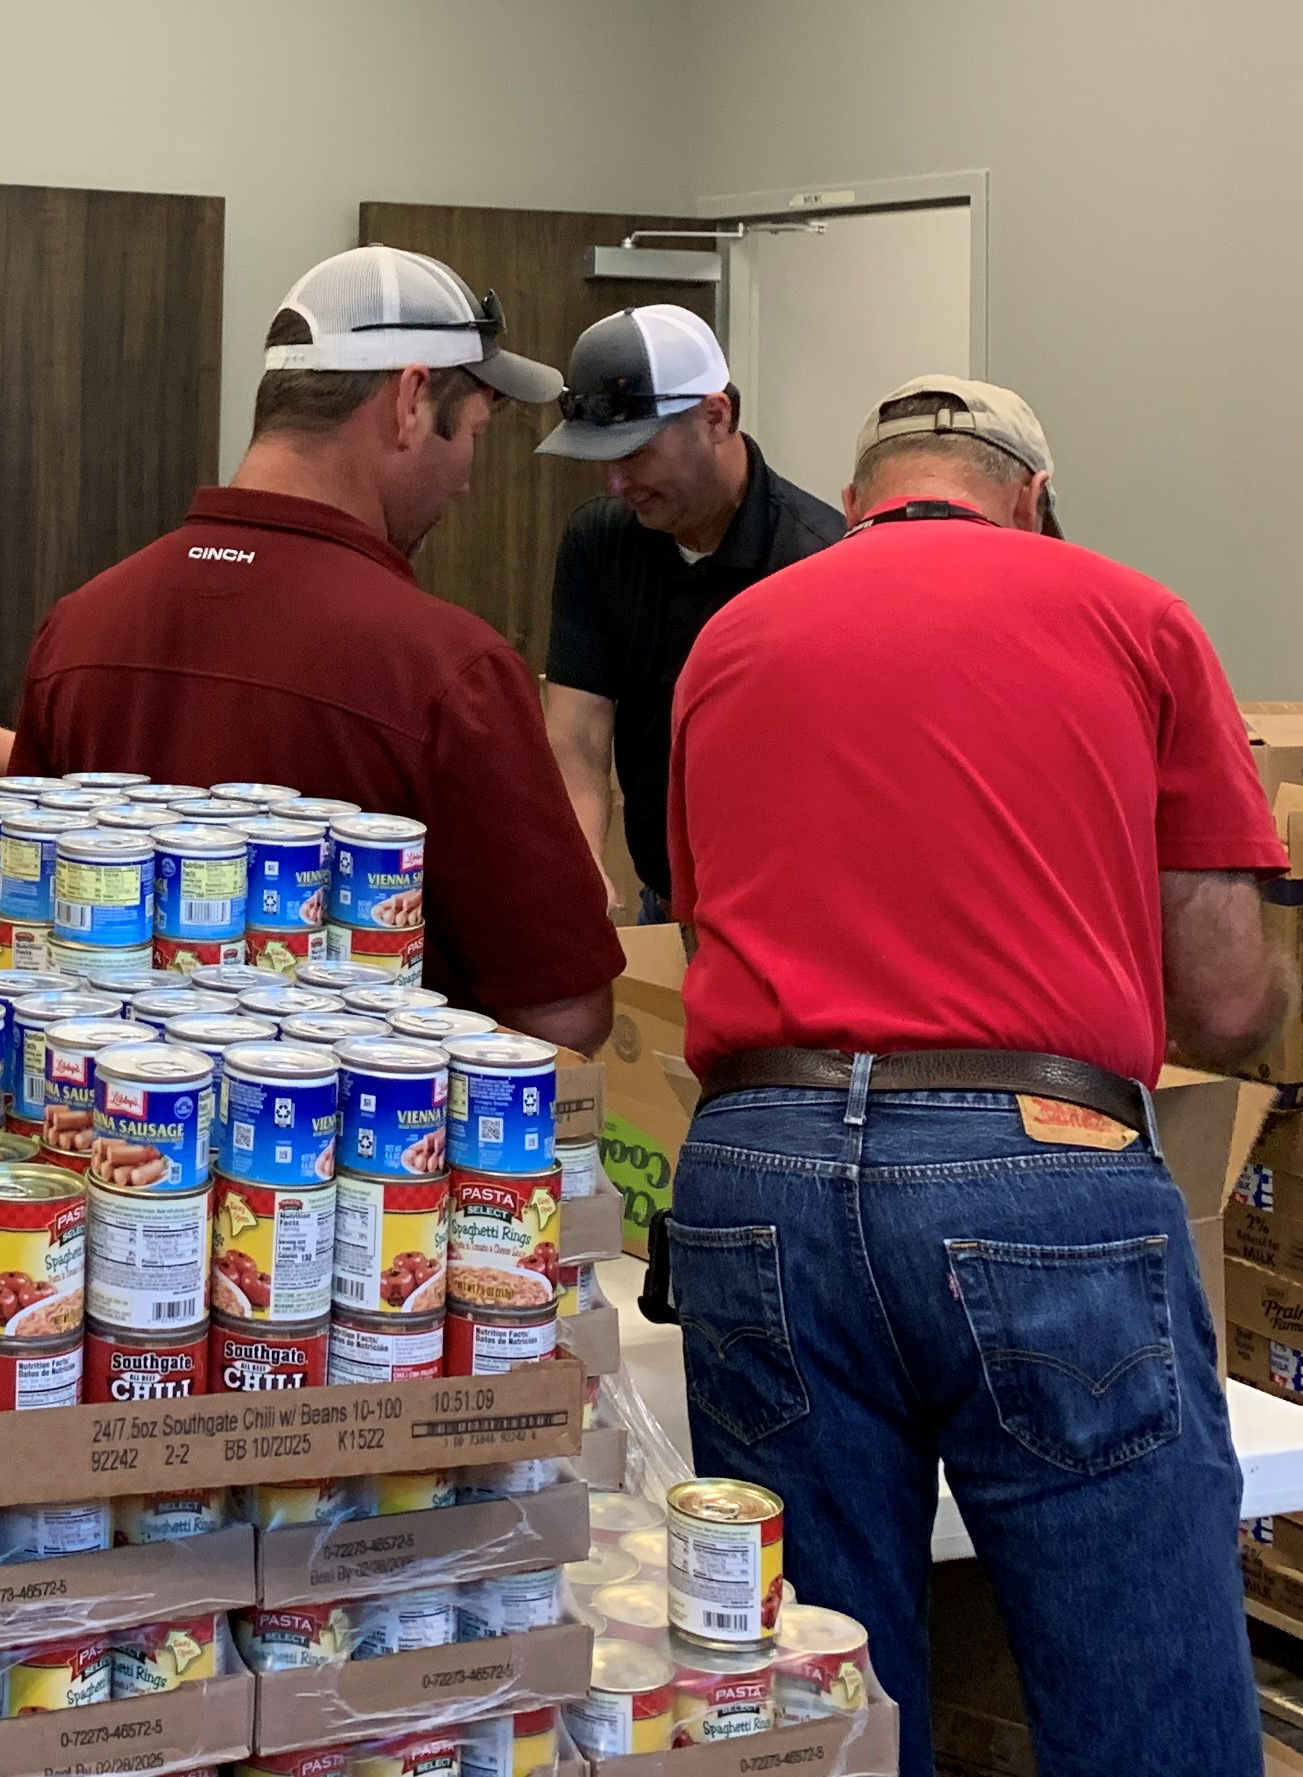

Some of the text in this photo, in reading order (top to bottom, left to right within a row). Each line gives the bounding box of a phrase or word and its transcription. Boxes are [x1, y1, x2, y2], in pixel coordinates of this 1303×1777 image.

[188, 546, 256, 564] CINCH
[367, 871, 410, 886] VIENNA
[397, 1109, 442, 1125] VIENNA
[119, 1119, 184, 1138] SAUSAGE
[462, 1187, 515, 1208] PASTA
[467, 1205, 509, 1219] SELECT
[451, 1219, 499, 1243] Spaghetti
[502, 1226, 532, 1248] Rings
[475, 1327, 507, 1338] Nutrition
[475, 1334, 496, 1344] Datos
[498, 1336, 507, 1345] de
[224, 1341, 305, 1365] Southgate
[19, 1362, 50, 1370] Nutrition
[111, 1354, 193, 1373] Southgate
[111, 1379, 191, 1401] CHILI
[92, 1397, 402, 1443] 24/7.5oz Southgate Chili w/ Beans 10-100
[91, 1428, 385, 1472] 92242 2-2 BB 10/2025 K1522
[259, 1614, 313, 1632] PASTA
[264, 1631, 306, 1645] SELECT
[135, 1665, 168, 1688] Rings
[715, 1684, 766, 1702] PASTA
[60, 1719, 163, 1747] 0-72273-46572-5
[702, 1720, 752, 1738] Spaghetti
